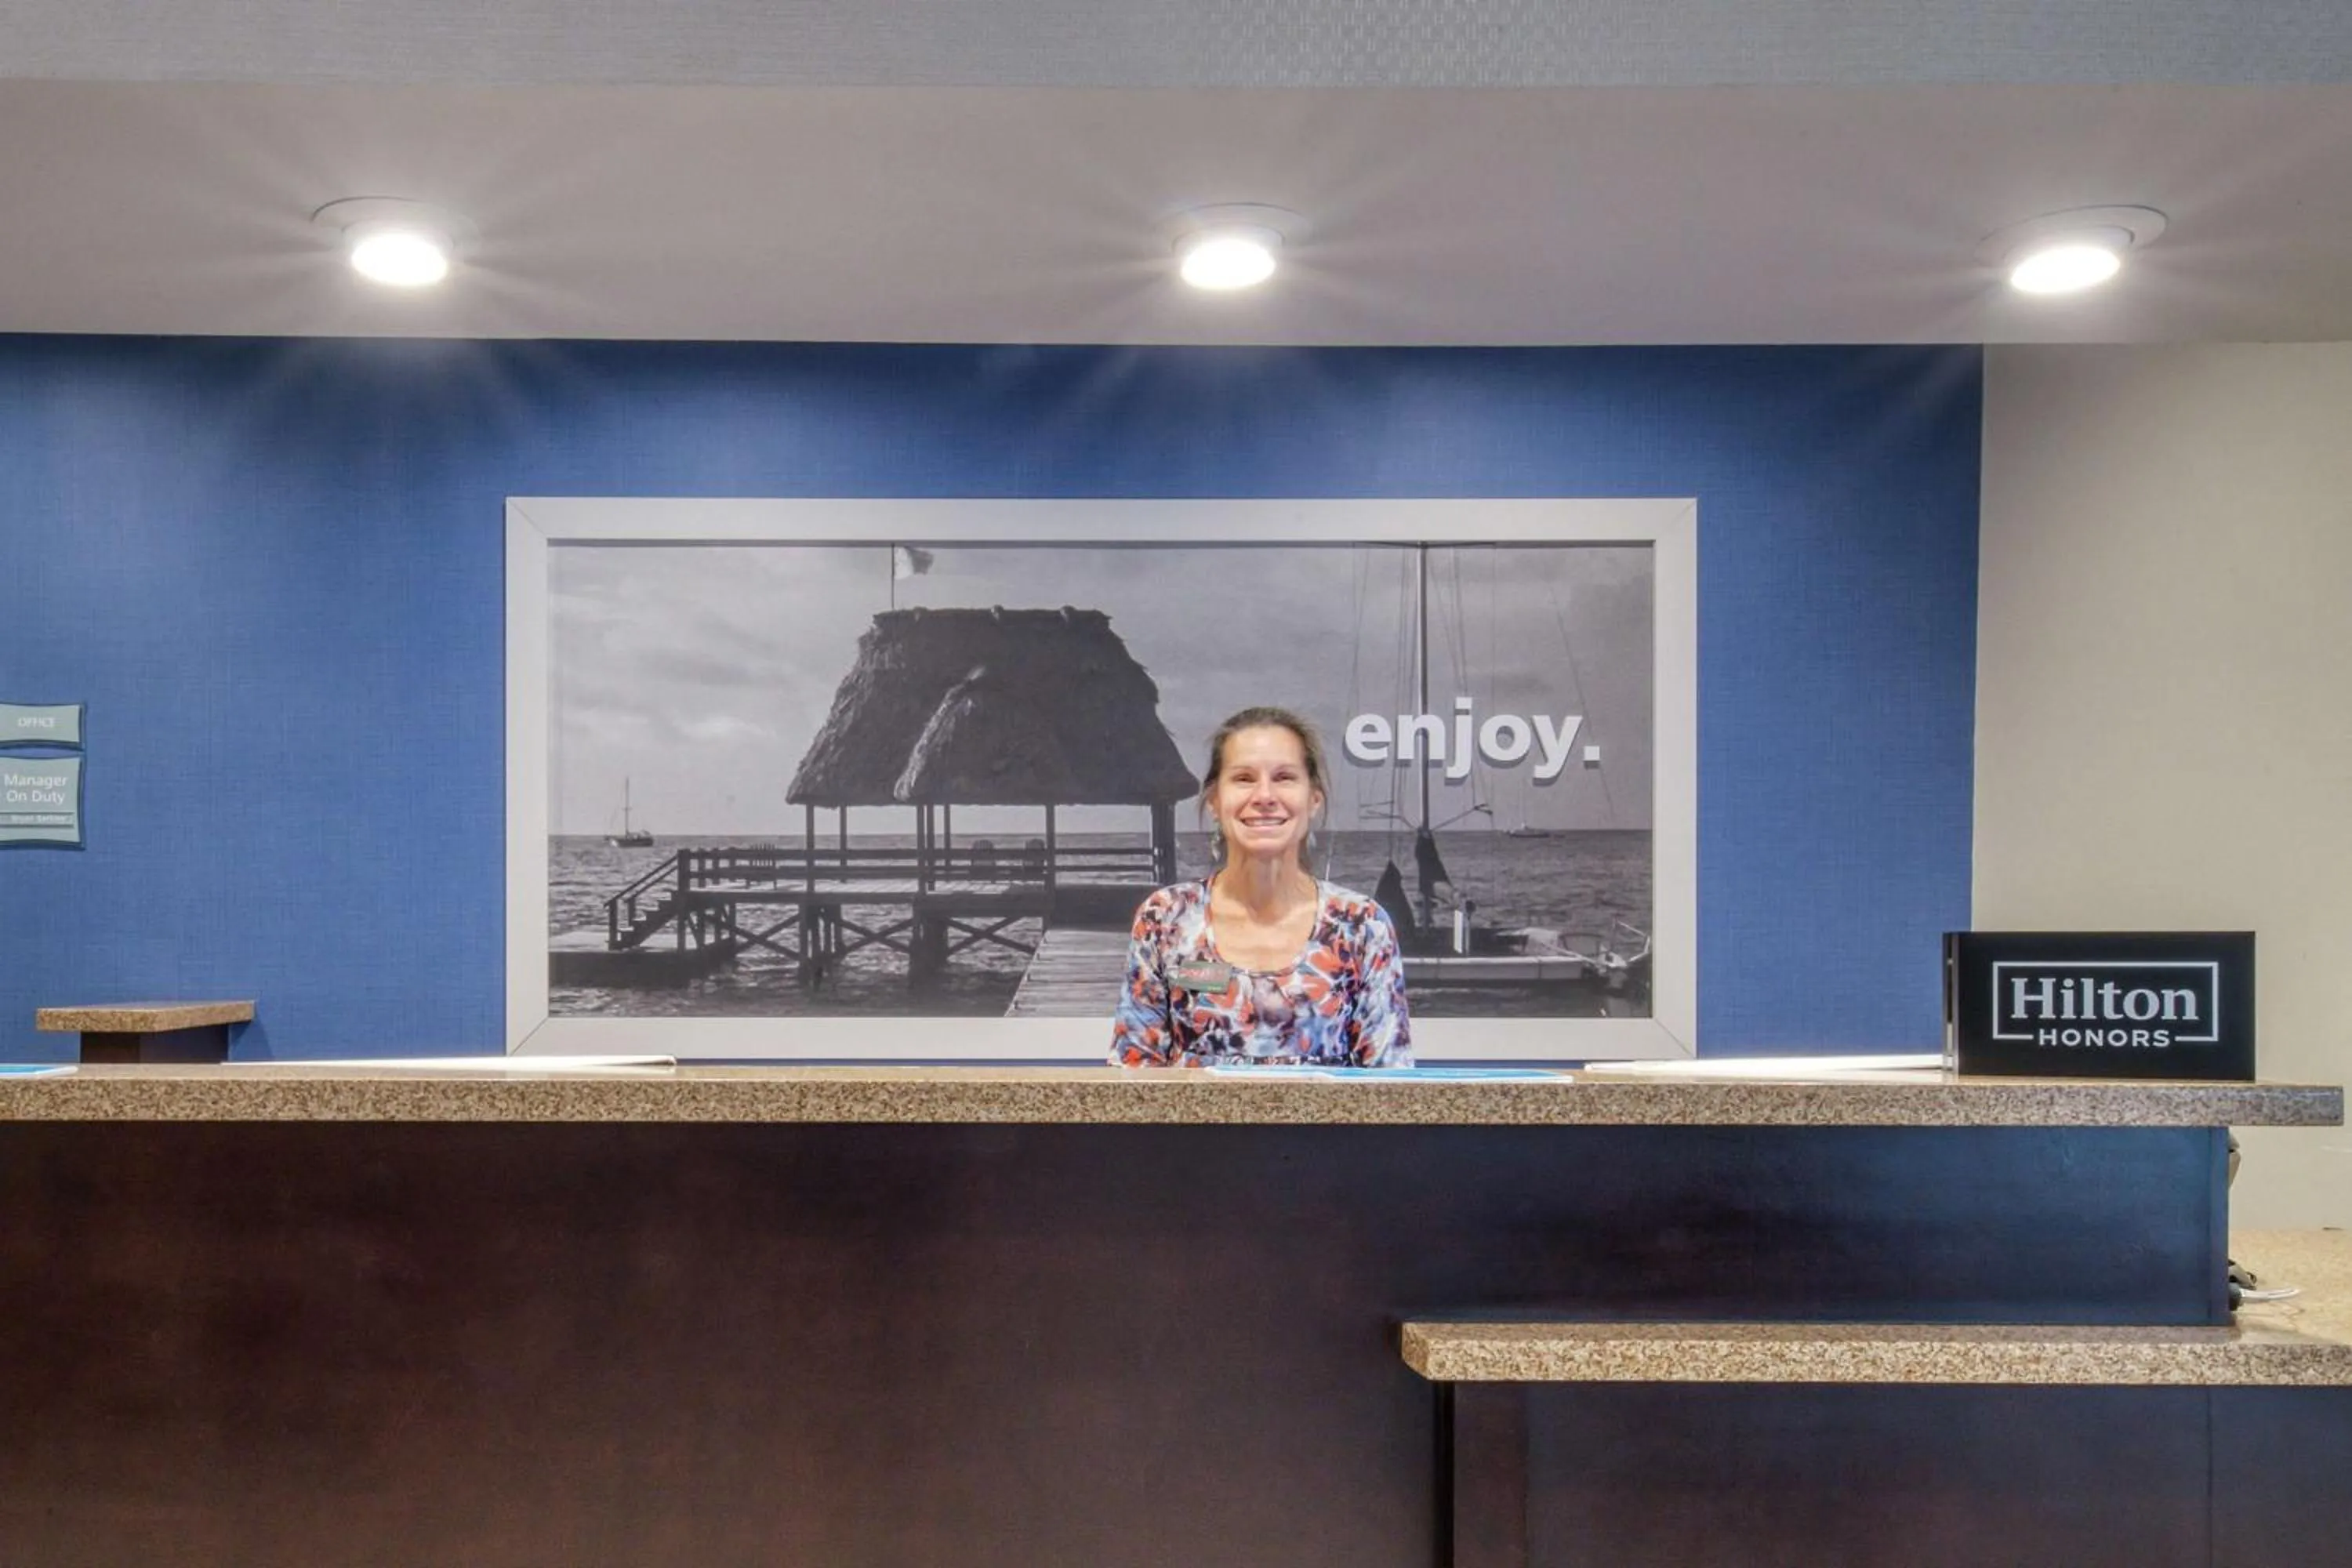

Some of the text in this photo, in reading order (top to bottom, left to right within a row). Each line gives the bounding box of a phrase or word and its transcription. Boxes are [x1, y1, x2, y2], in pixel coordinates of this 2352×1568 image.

[1344, 696, 1600, 779] enjoy.
[4, 774, 68, 789] Manager
[6, 789, 65, 806] On Duty
[2009, 977, 2200, 1021] Hilton
[2039, 1028, 2171, 1047] HONORS
